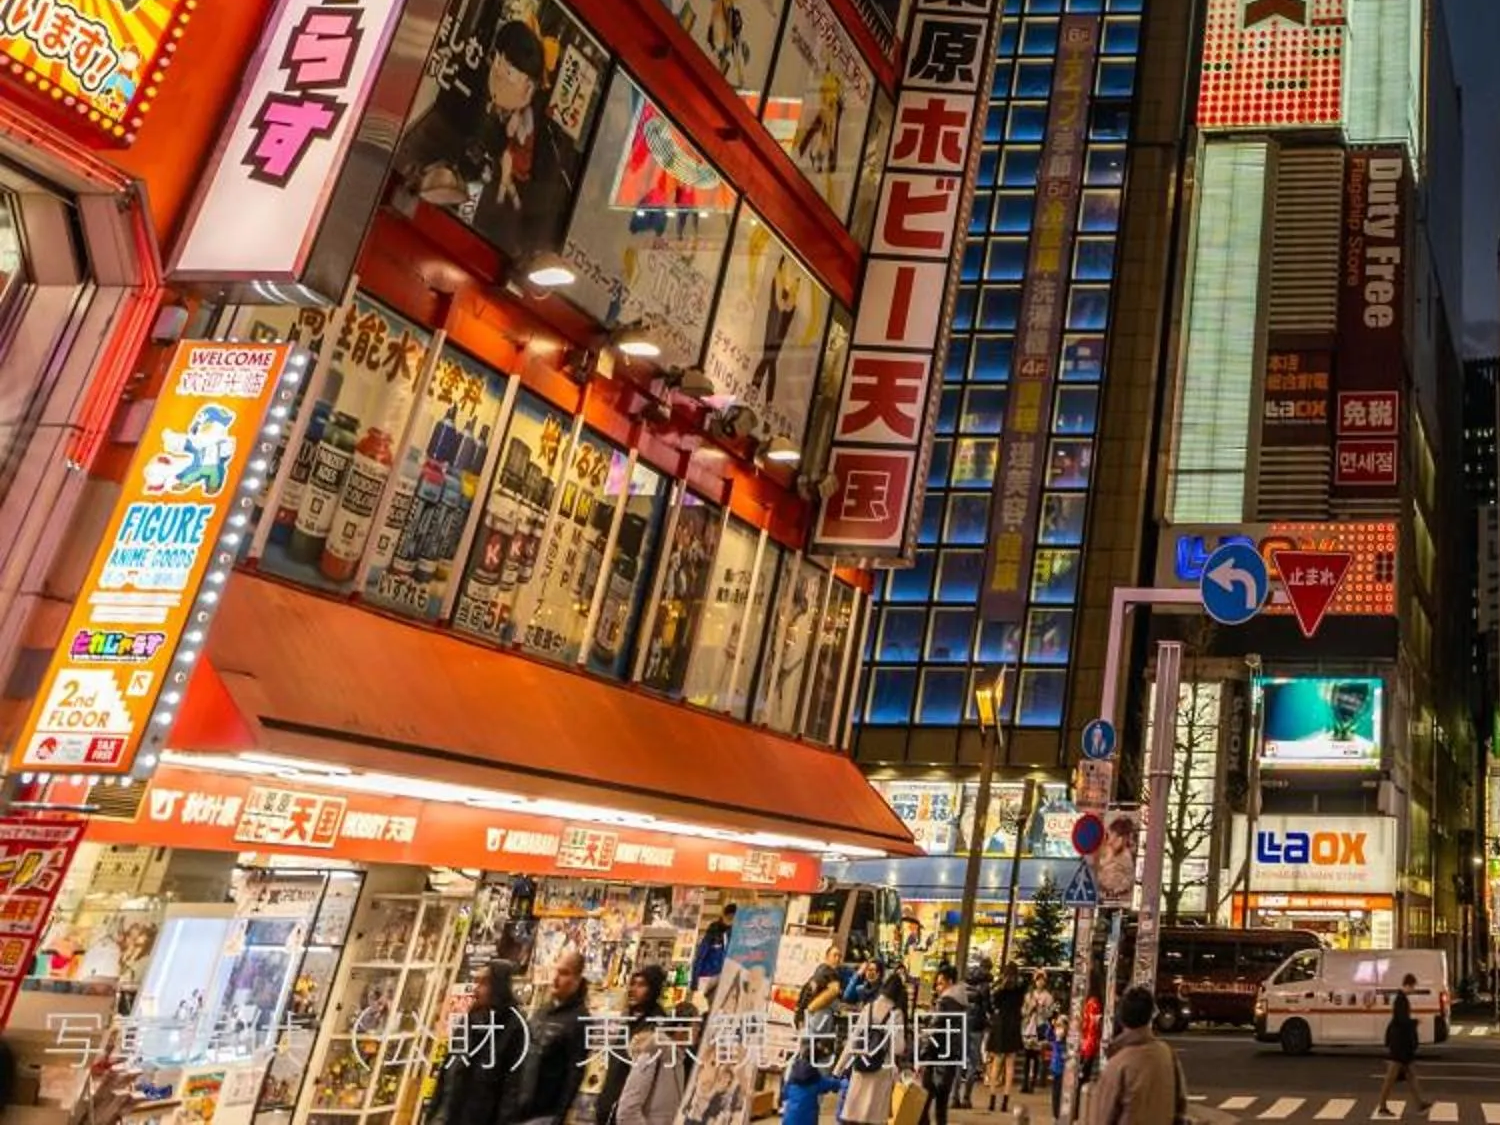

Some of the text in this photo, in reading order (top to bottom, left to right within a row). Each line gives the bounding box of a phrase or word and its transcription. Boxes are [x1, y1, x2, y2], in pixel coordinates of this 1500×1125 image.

[1362, 156, 1402, 329] Duty Free
[189, 350, 274, 367] WELCOME
[1342, 400, 1394, 426] 免税
[118, 504, 214, 547] FIGURE
[1288, 569, 1336, 587] 止まれ
[60, 679, 97, 709] 2nd
[47, 708, 110, 729] FLOOR
